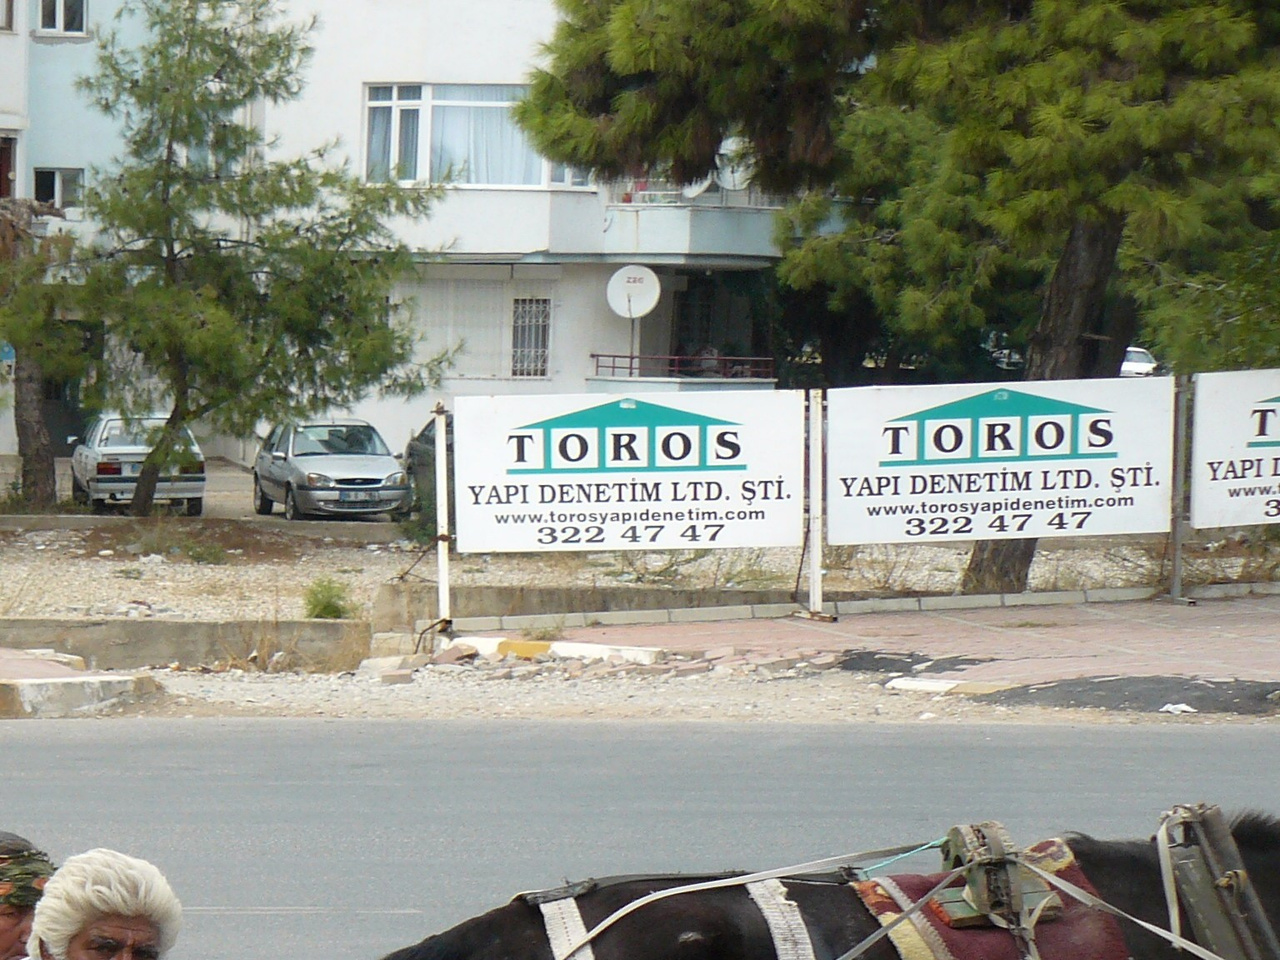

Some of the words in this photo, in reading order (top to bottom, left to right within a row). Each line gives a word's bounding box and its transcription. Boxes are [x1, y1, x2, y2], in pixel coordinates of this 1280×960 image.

[507, 431, 742, 463] TOROS
[882, 418, 1114, 455] TOROS
[840, 475, 901, 498] YAPI
[909, 467, 1031, 495] DENETİM
[1041, 468, 1099, 490] LTD.
[1110, 461, 1160, 494] ŞTİ.
[1207, 458, 1264, 481] YAPI
[467, 484, 529, 505] YAPI
[538, 477, 662, 504] DENETİM
[671, 481, 730, 502] LTD.
[741, 474, 791, 506] ŞTİ.
[867, 496, 1134, 517] www.torosyapidenetim.com
[537, 526, 605, 544] 322
[621, 525, 665, 542] 47
[680, 524, 725, 541] 47
[905, 516, 973, 536] 322
[987, 514, 1033, 532] 47
[1047, 512, 1092, 530] 47
